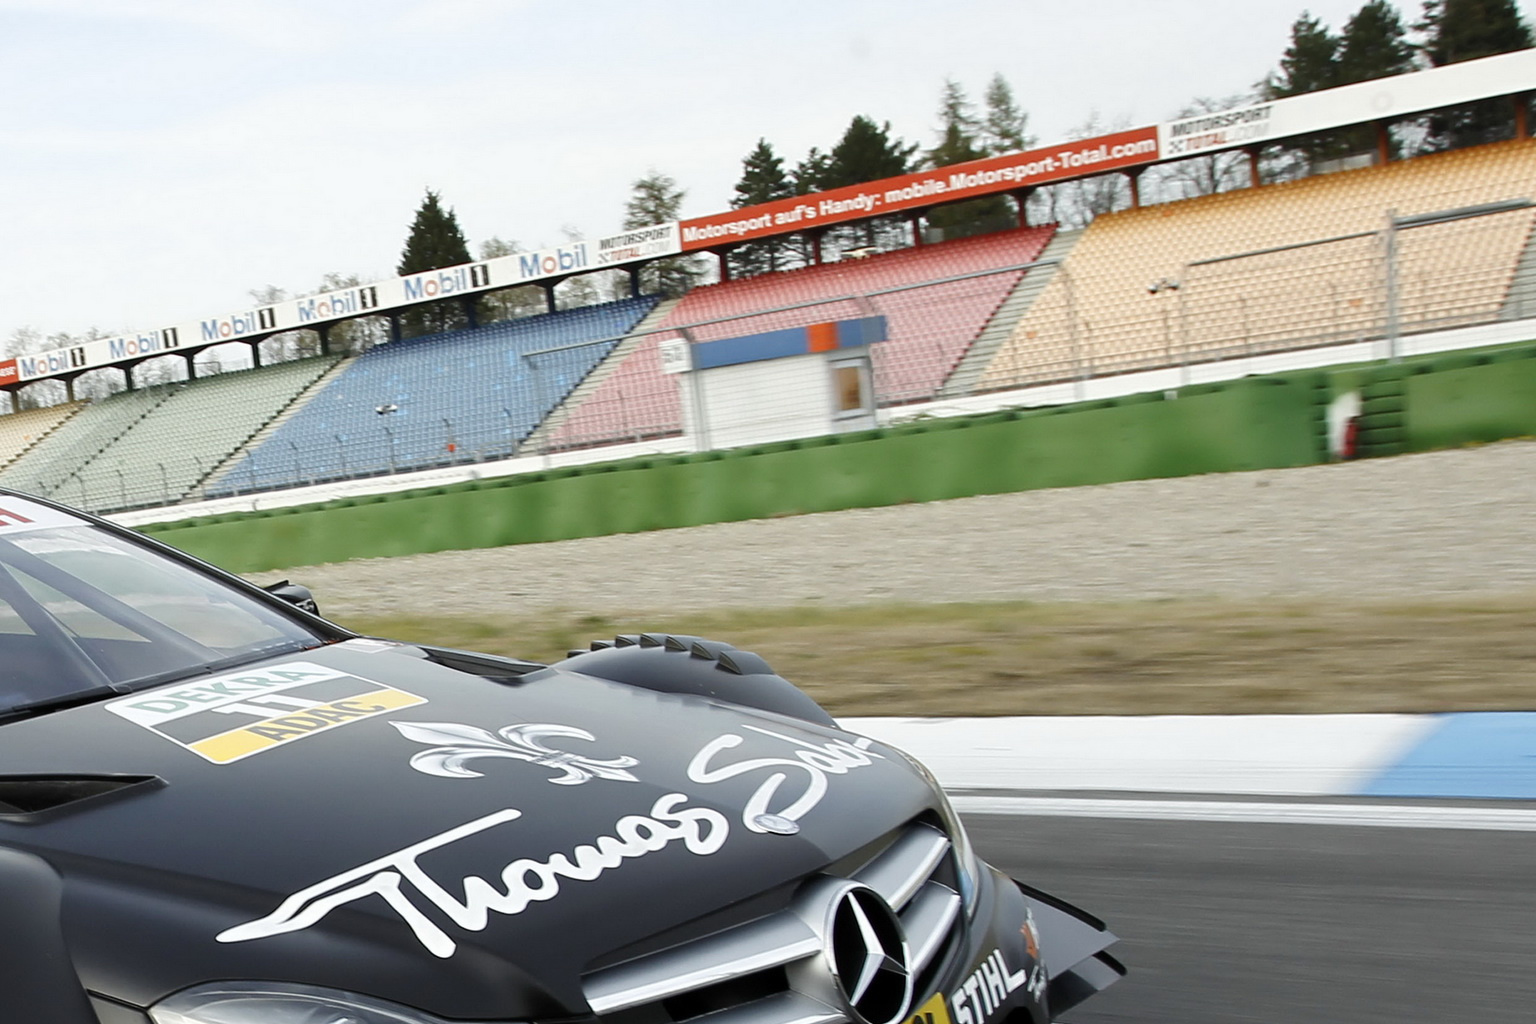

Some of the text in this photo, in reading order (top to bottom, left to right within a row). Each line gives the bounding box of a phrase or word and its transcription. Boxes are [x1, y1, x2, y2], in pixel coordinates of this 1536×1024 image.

[1171, 105, 1272, 137] MOTORSPORT
[683, 138, 1156, 242] Motorsport auf's Handy: mobile.Motorsport-Total.com
[599, 226, 672, 249] MOTORSPORT
[519, 243, 588, 278] Mobil
[403, 264, 490, 300] Mobil 1
[298, 286, 378, 322] Mobil 1
[201, 307, 275, 341] Mobil 1
[109, 327, 178, 359] Mobil 1
[21, 355, 68, 378] Mobil
[126, 670, 332, 714] DEKRA
[211, 694, 322, 719] 11
[246, 700, 386, 742] ADAC
[215, 793, 730, 959] Thomas
